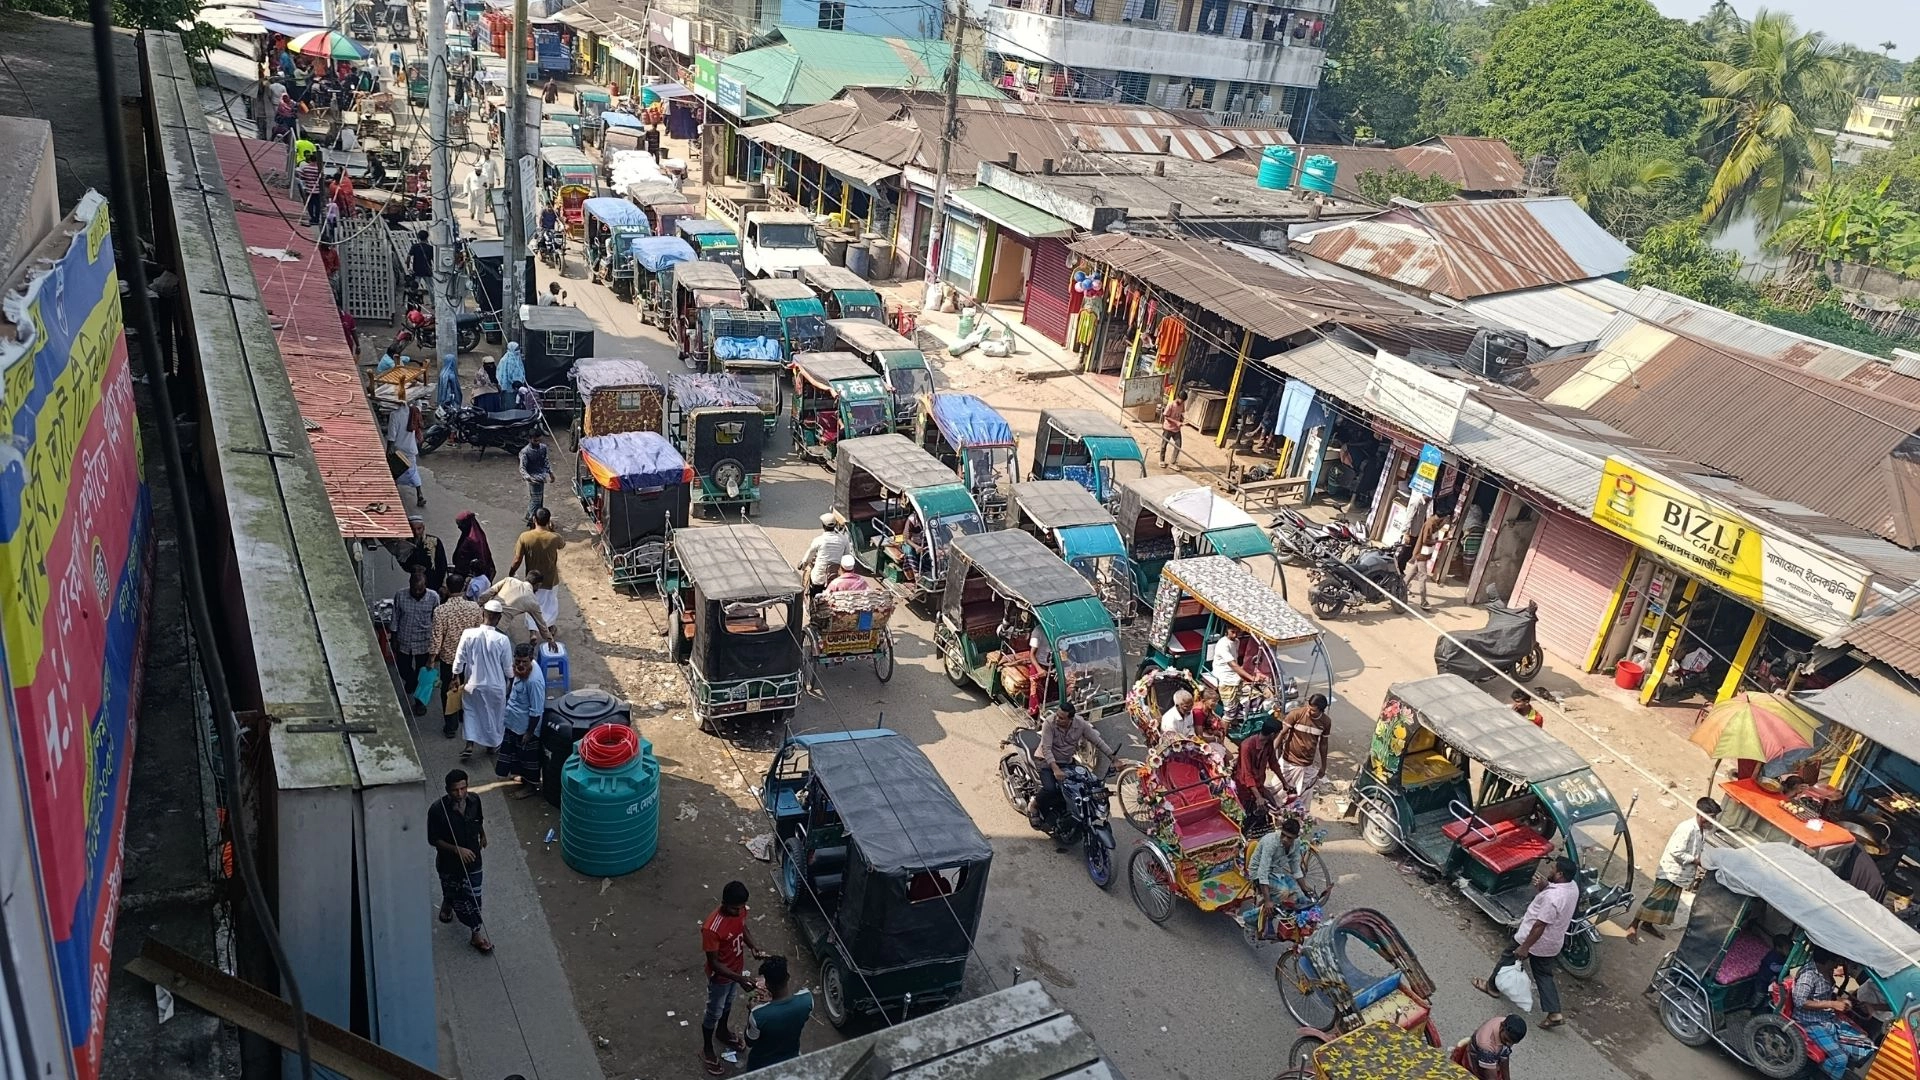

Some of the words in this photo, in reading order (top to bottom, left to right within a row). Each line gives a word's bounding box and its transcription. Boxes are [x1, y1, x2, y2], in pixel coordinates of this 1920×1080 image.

[1656, 534, 1692, 561] নিরাপদ
[1691, 553, 1732, 580] আজীবন
[1691, 537, 1737, 566] CABLES
